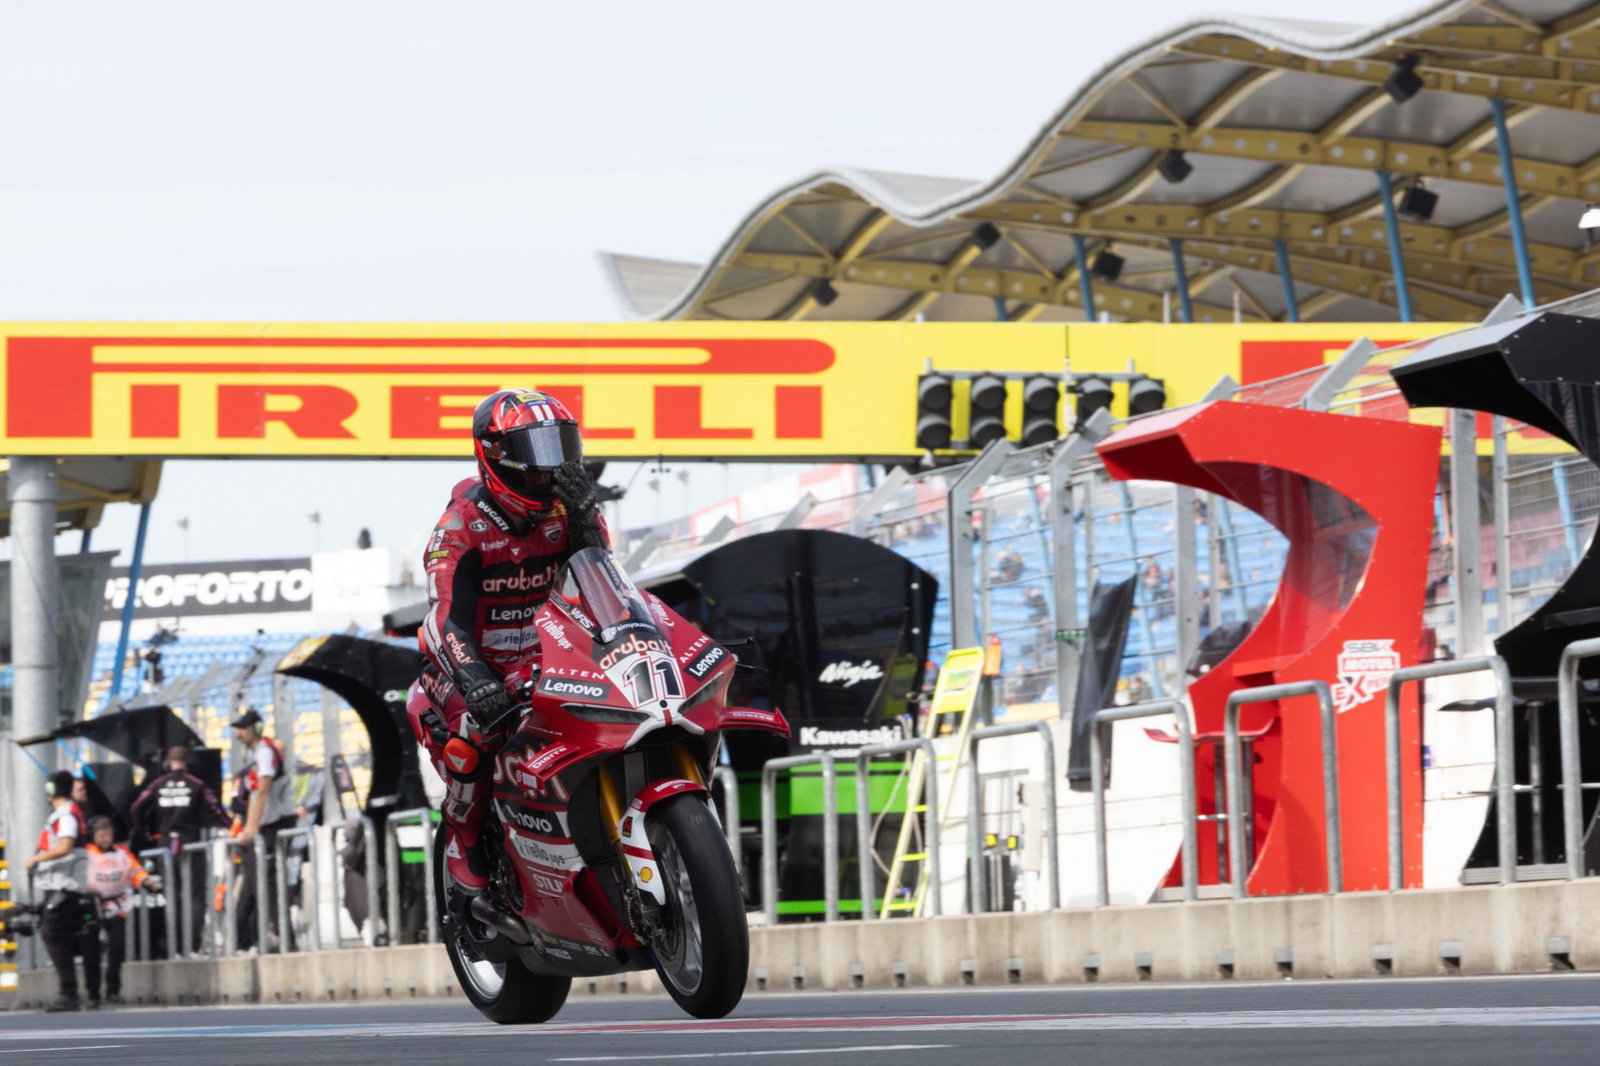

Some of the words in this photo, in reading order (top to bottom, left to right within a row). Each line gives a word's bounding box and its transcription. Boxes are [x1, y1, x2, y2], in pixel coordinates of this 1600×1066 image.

[6, 336, 837, 440] PIRELLI
[476, 500, 510, 532] DUCATI
[491, 603, 543, 621] Lenov
[680, 635, 710, 664] ALTEN
[688, 647, 724, 677] Lenovo
[545, 667, 606, 680] ALTEN
[624, 658, 682, 704] 11
[818, 660, 884, 688] Ninja
[545, 679, 603, 697] Lenovo
[799, 726, 902, 746] Kawasaki
[531, 746, 568, 769] Dierre
[504, 803, 553, 833] Lnovo
